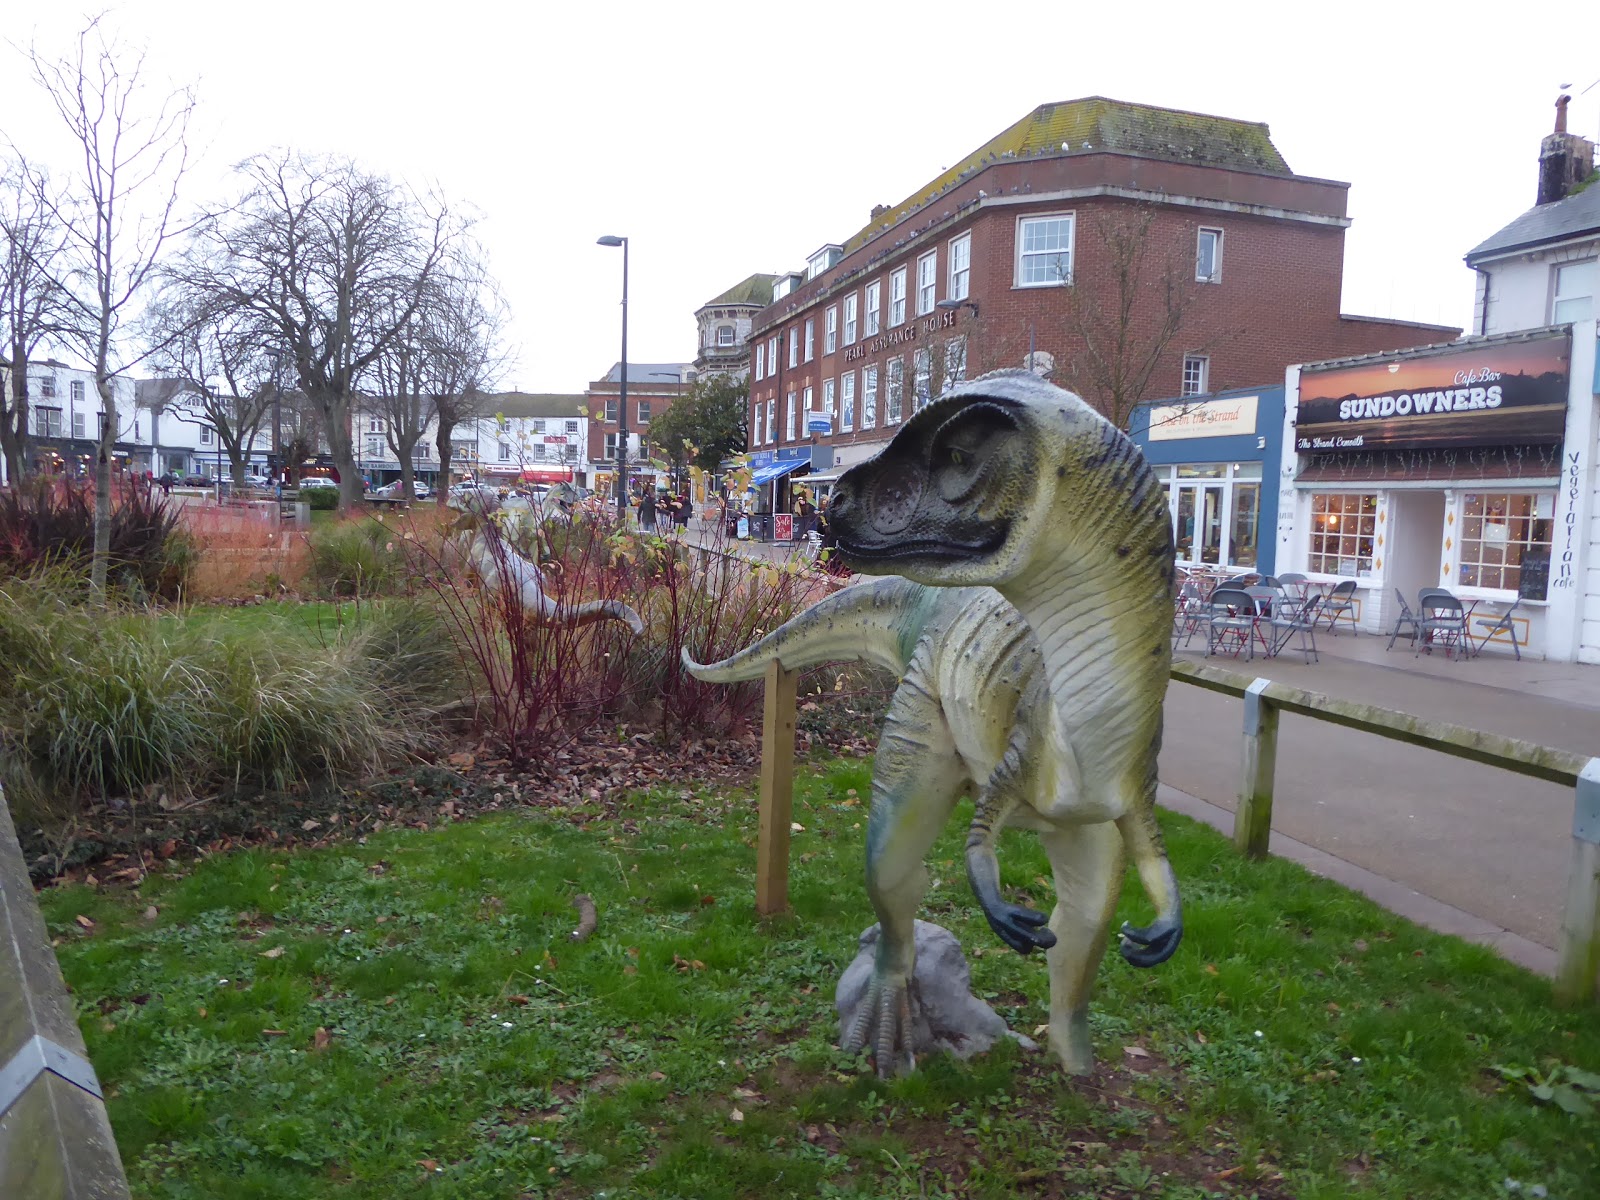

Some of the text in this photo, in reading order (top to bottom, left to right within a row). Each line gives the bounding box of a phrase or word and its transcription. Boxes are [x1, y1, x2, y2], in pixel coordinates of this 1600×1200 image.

[844, 310, 956, 362] PEARL ASSURANCE HOUSE
[1454, 367, 1502, 387] Cafe Bar
[1339, 385, 1503, 420] SUNDOWNERS
[775, 515, 791, 528] Sale
